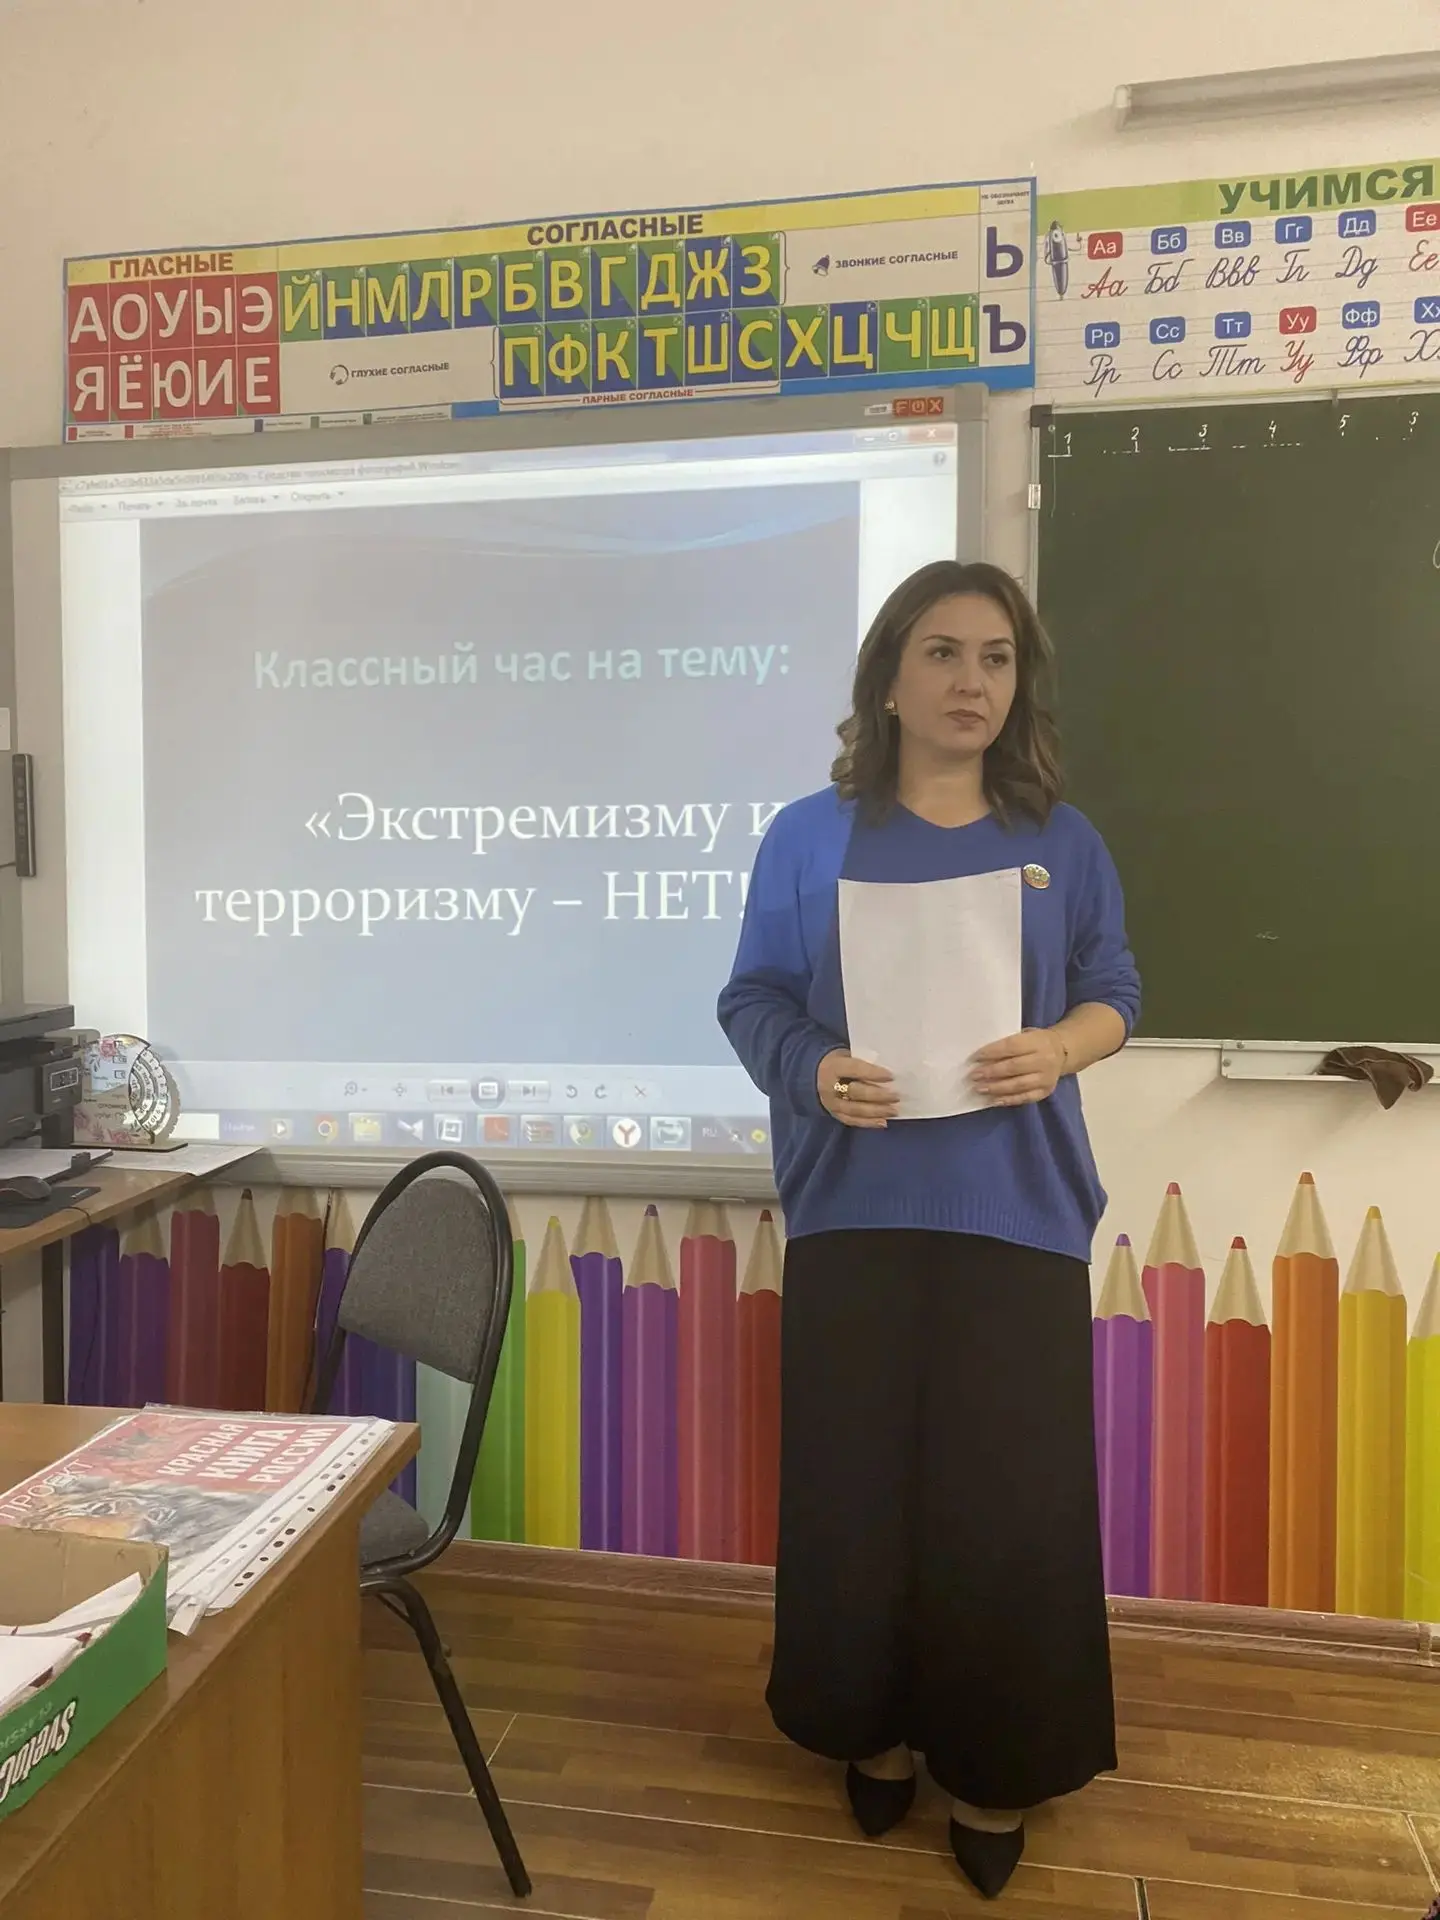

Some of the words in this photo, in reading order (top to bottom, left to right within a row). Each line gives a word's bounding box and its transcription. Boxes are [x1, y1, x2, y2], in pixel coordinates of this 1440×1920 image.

[1218, 164, 1434, 215] УЧИМСЯ
[527, 213, 704, 247] СОГЛАСНЫЕ
[1093, 241, 1117, 255] Аа
[1157, 233, 1181, 250] Бб
[1221, 228, 1244, 244] Вв
[1284, 224, 1304, 238] Гг
[1344, 216, 1370, 235] Дд
[1413, 211, 1437, 228] Ее
[109, 252, 234, 279] ГЛАСНЫЕ
[835, 256, 886, 269] ЗВОНКИЕ
[889, 250, 959, 265] СОГЛАСНЫЕ
[1091, 328, 1115, 348] Рр
[1155, 324, 1180, 340] Сс
[1221, 319, 1244, 335] Тт
[1285, 313, 1310, 332] Уу
[1345, 307, 1377, 326] Фф
[351, 368, 387, 378] ГЛУХИЕ
[390, 362, 450, 375] СОГЛАСНЫЕ
[582, 393, 627, 404] ПАРНЫЕ
[629, 388, 694, 401] СОГЛАСНЫЕ
[254, 642, 477, 690] Классный
[495, 649, 571, 684] час
[588, 645, 641, 680] на
[657, 643, 791, 687] тему:
[304, 792, 732, 853] «Экстремизму
[196, 879, 536, 937] терроризму
[156, 1423, 249, 1476] КРАСНАЯ
[197, 1428, 297, 1479] КНИГА
[247, 1427, 337, 1483] РОССИИ
